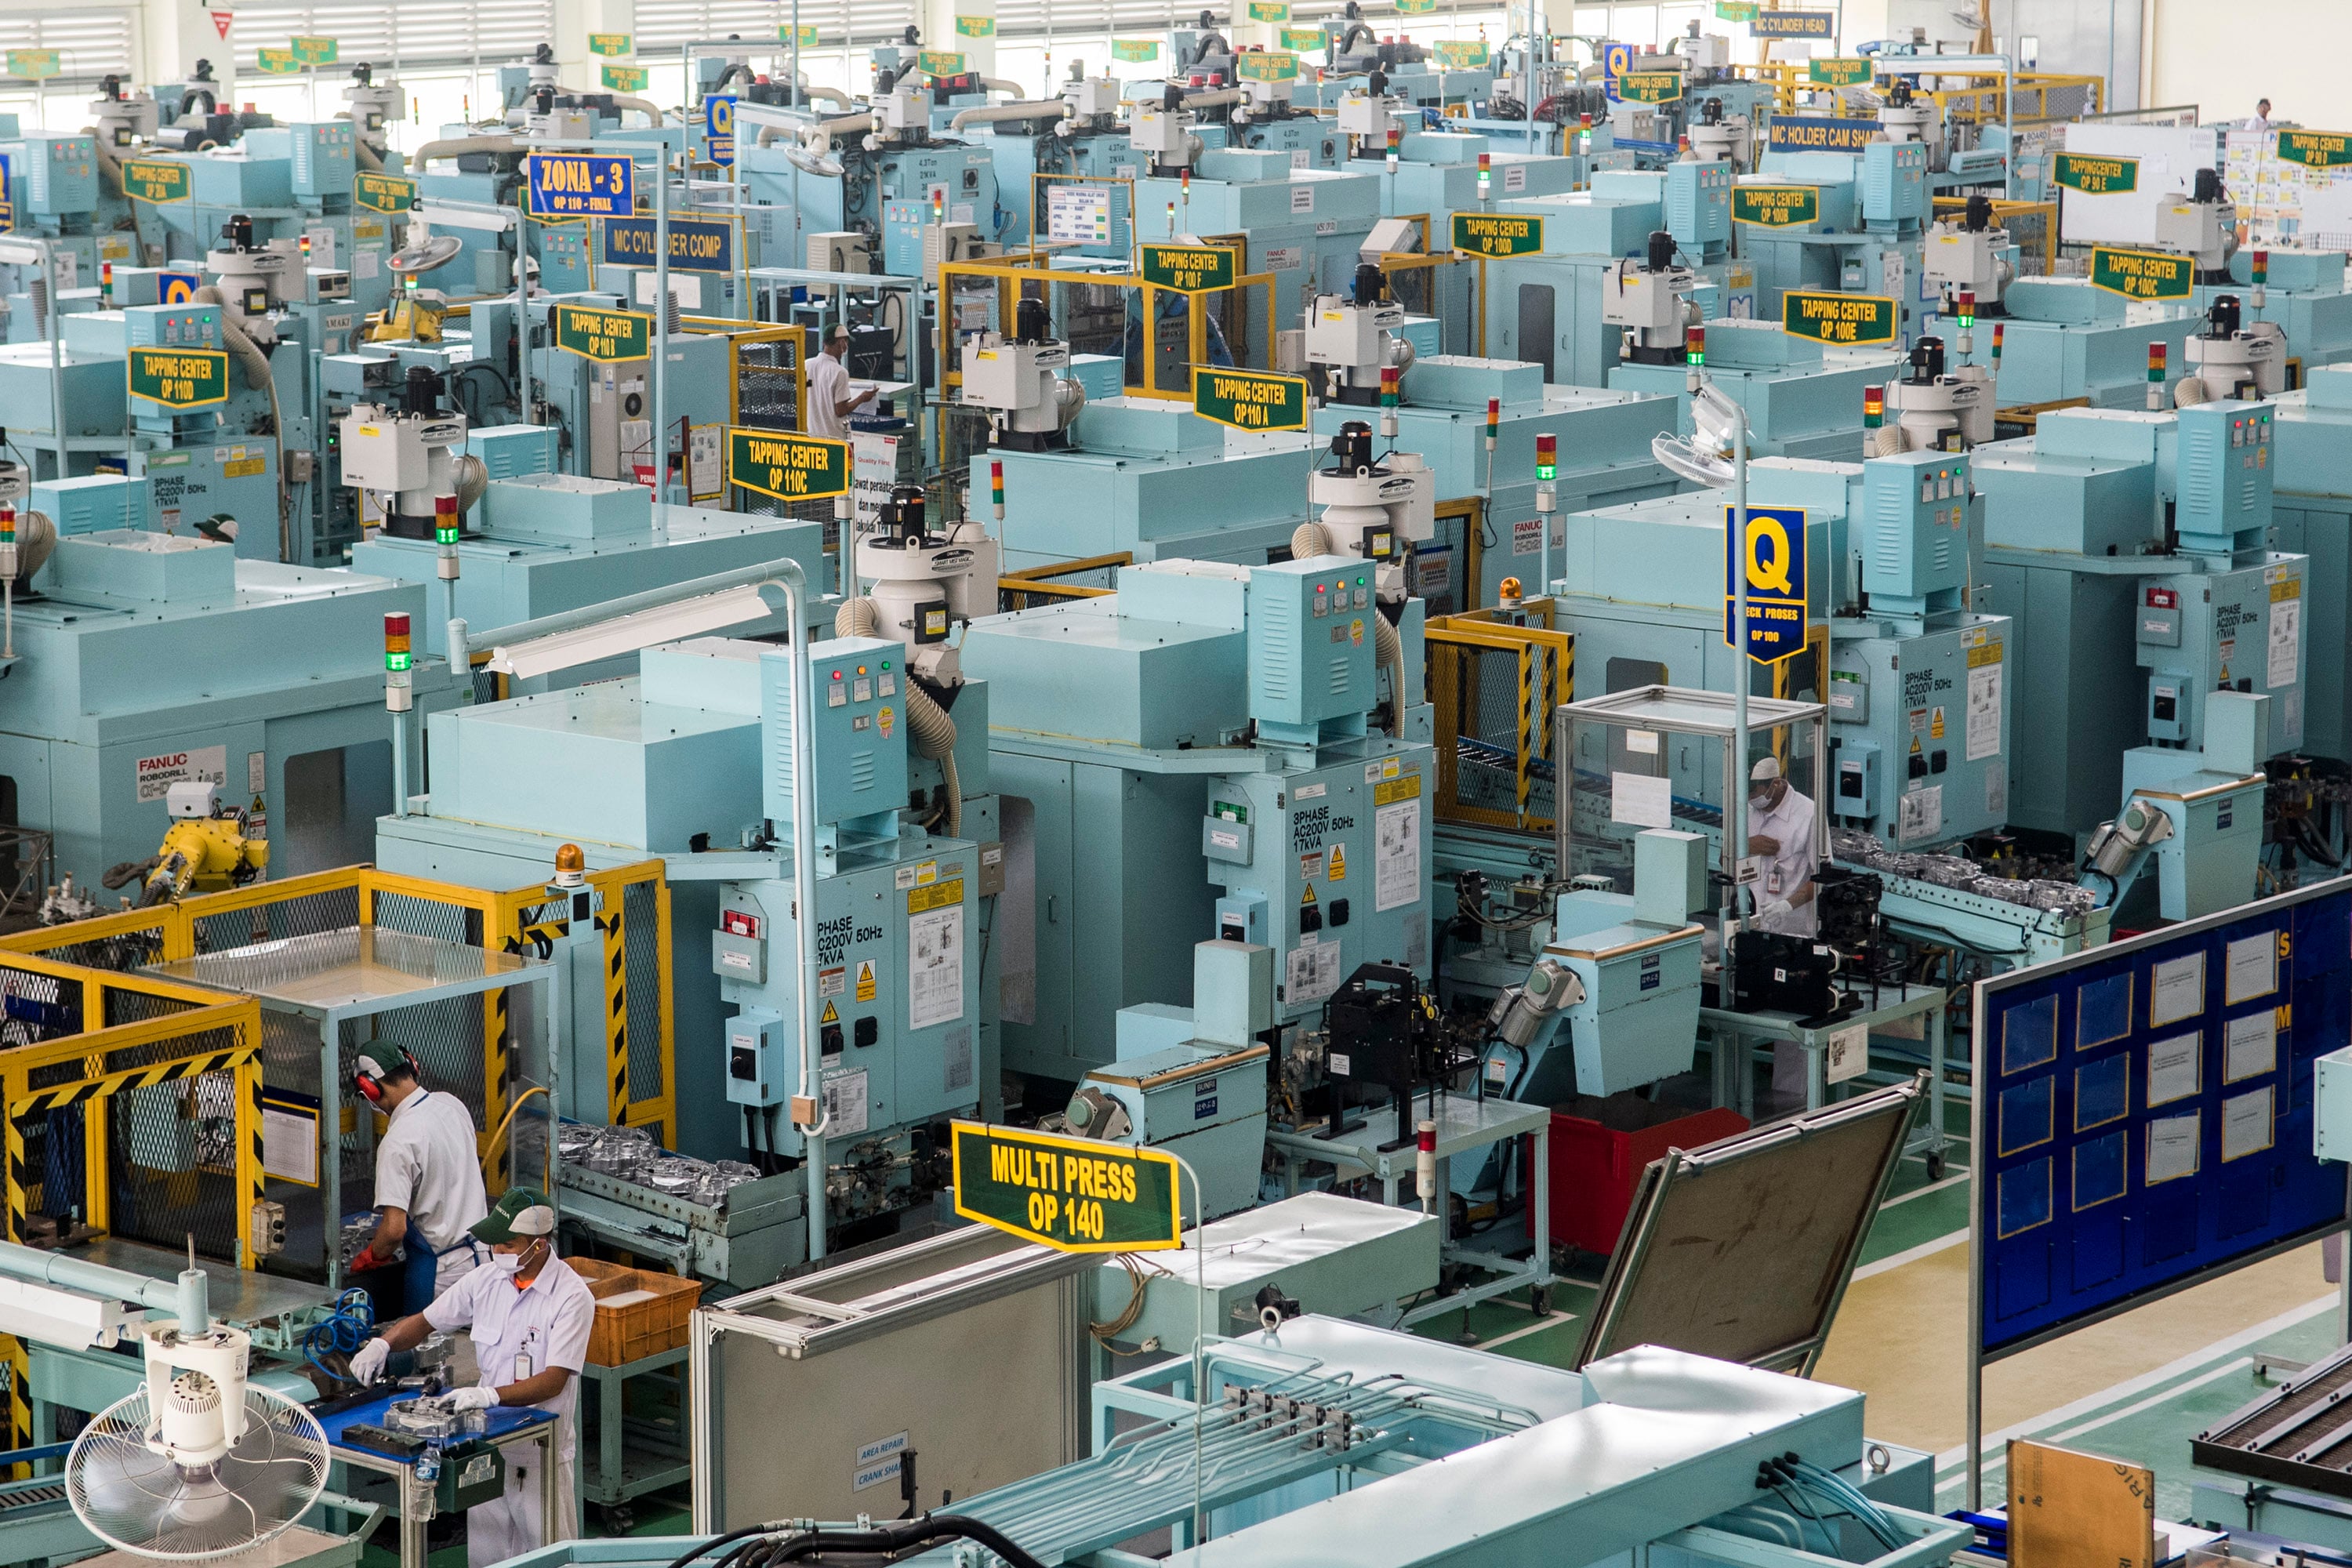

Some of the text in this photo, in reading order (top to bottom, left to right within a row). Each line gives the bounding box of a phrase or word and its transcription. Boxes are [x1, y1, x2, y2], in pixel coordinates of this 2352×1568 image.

[1769, 18, 1802, 34] CYLINDER
[1805, 20, 1826, 34] HEAD
[1610, 47, 1628, 77] Q
[712, 100, 735, 136] Q
[1770, 123, 1785, 144] MC
[1787, 124, 1826, 146] HOLDER
[1828, 128, 1849, 147] CAM
[2292, 135, 2318, 151] TAPPING
[2319, 137, 2346, 155] CENTER
[541, 160, 593, 193] ZONA
[610, 162, 624, 195] 3
[2081, 176, 2091, 190] OP
[554, 196, 613, 212] OP 110 FINAL
[1745, 191, 1805, 209] TAPPING CENTER
[1761, 208, 1772, 223] OP
[1467, 220, 1529, 238] TAPPING CENTER
[614, 229, 721, 260] MC CYLIER COMP
[1482, 237, 1513, 254] OP 100D
[1157, 250, 1218, 272] TAPPING CENTER
[2108, 255, 2177, 284] TAPPING CENTER
[1174, 270, 1202, 289] OP 100 F
[2125, 276, 2158, 296] OP 100C
[1802, 299, 1877, 322] TAPPING CENTER
[571, 313, 633, 339] TAPPING CENTER
[1820, 321, 1857, 341] OP 100E
[589, 336, 617, 358] OP 110 B
[143, 357, 212, 380] TAPPING CENTER
[161, 379, 194, 401] OP 110D
[1214, 378, 1287, 408] TAPPING CENTER
[1234, 402, 1269, 426] OP 110 A
[749, 441, 829, 472] TAPPING CENTER
[858, 456, 877, 468] Quality
[154, 475, 186, 489] 3PHASE
[187, 482, 207, 495] 50Hz
[768, 468, 808, 494] OP 110C
[1746, 516, 1792, 596] Q
[1765, 608, 1798, 622] PROSES
[2217, 603, 2241, 618] 3PHASE
[2216, 615, 2241, 630] AC200V
[1751, 630, 1780, 643] OP 100
[1904, 669, 1933, 685] 3PHASE
[1904, 678, 1952, 697] AC200V 50Hz
[1904, 695, 1927, 710] 17kVA
[139, 753, 188, 772] FANUC
[140, 769, 188, 783] ROBODRILL
[1293, 805, 1330, 826] 3PHASE
[1293, 815, 1354, 840] AC200V 50Hz
[1293, 835, 1323, 853] 17kVA
[818, 916, 853, 937] PHASE
[818, 925, 883, 952] C200V 50Hz
[2279, 932, 2291, 956] S
[818, 949, 845, 967] 7kVA
[2276, 1004, 2291, 1029] M
[1196, 1080, 1216, 1093] BUNRI
[991, 1144, 1138, 1203] MULTI PRESS
[1028, 1192, 1105, 1241] OP 140
[861, 1438, 904, 1461] AREA REPAIR
[858, 1463, 902, 1486] CRANK SHA
